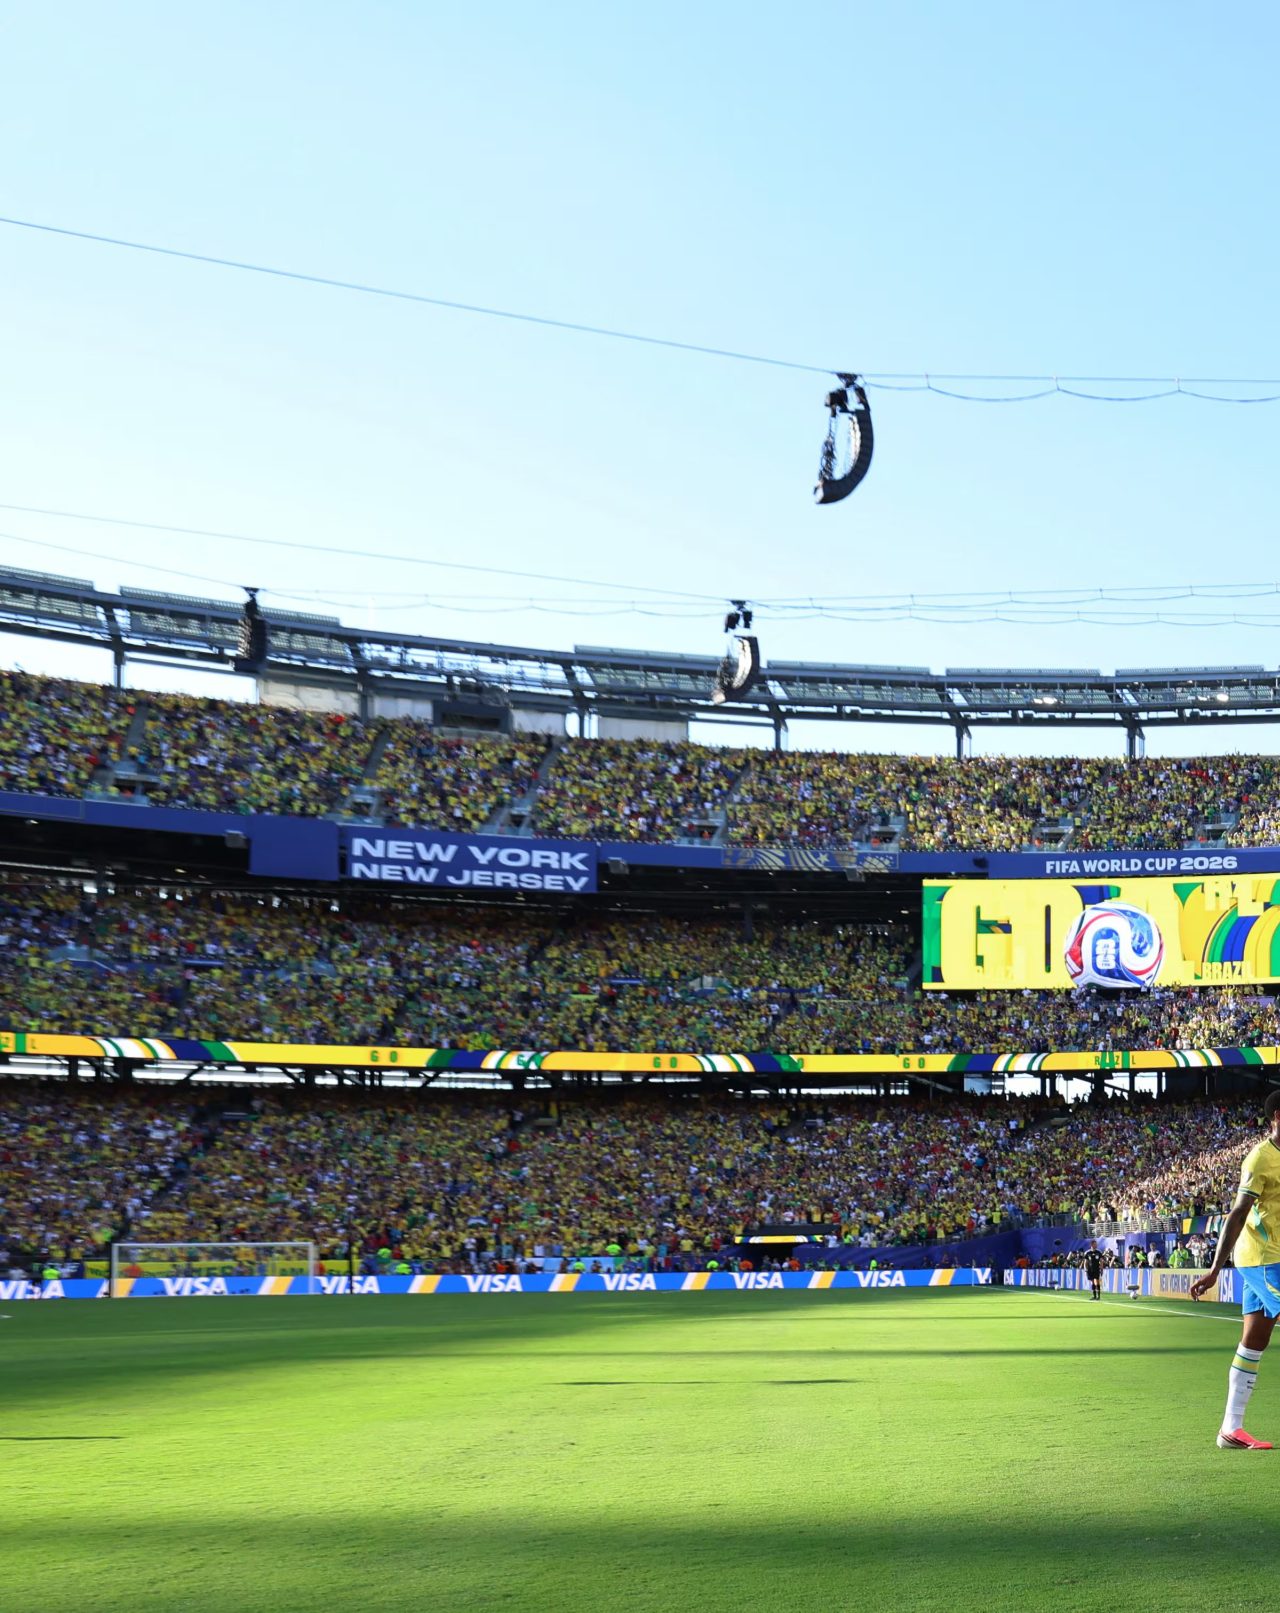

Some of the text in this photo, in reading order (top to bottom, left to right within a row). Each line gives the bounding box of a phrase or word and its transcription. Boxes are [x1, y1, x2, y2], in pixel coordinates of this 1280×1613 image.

[352, 838, 589, 871] NEW YORK
[1045, 856, 1238, 874] FIFA WORLD CUP 2026
[352, 862, 589, 891] NEW JERSEY
[157, 1277, 228, 1296] VISA
[314, 1276, 380, 1294] VISA
[461, 1274, 523, 1293] VISA
[599, 1272, 656, 1291] VISA
[728, 1271, 785, 1290] VISA
[852, 1270, 907, 1288] VISA
